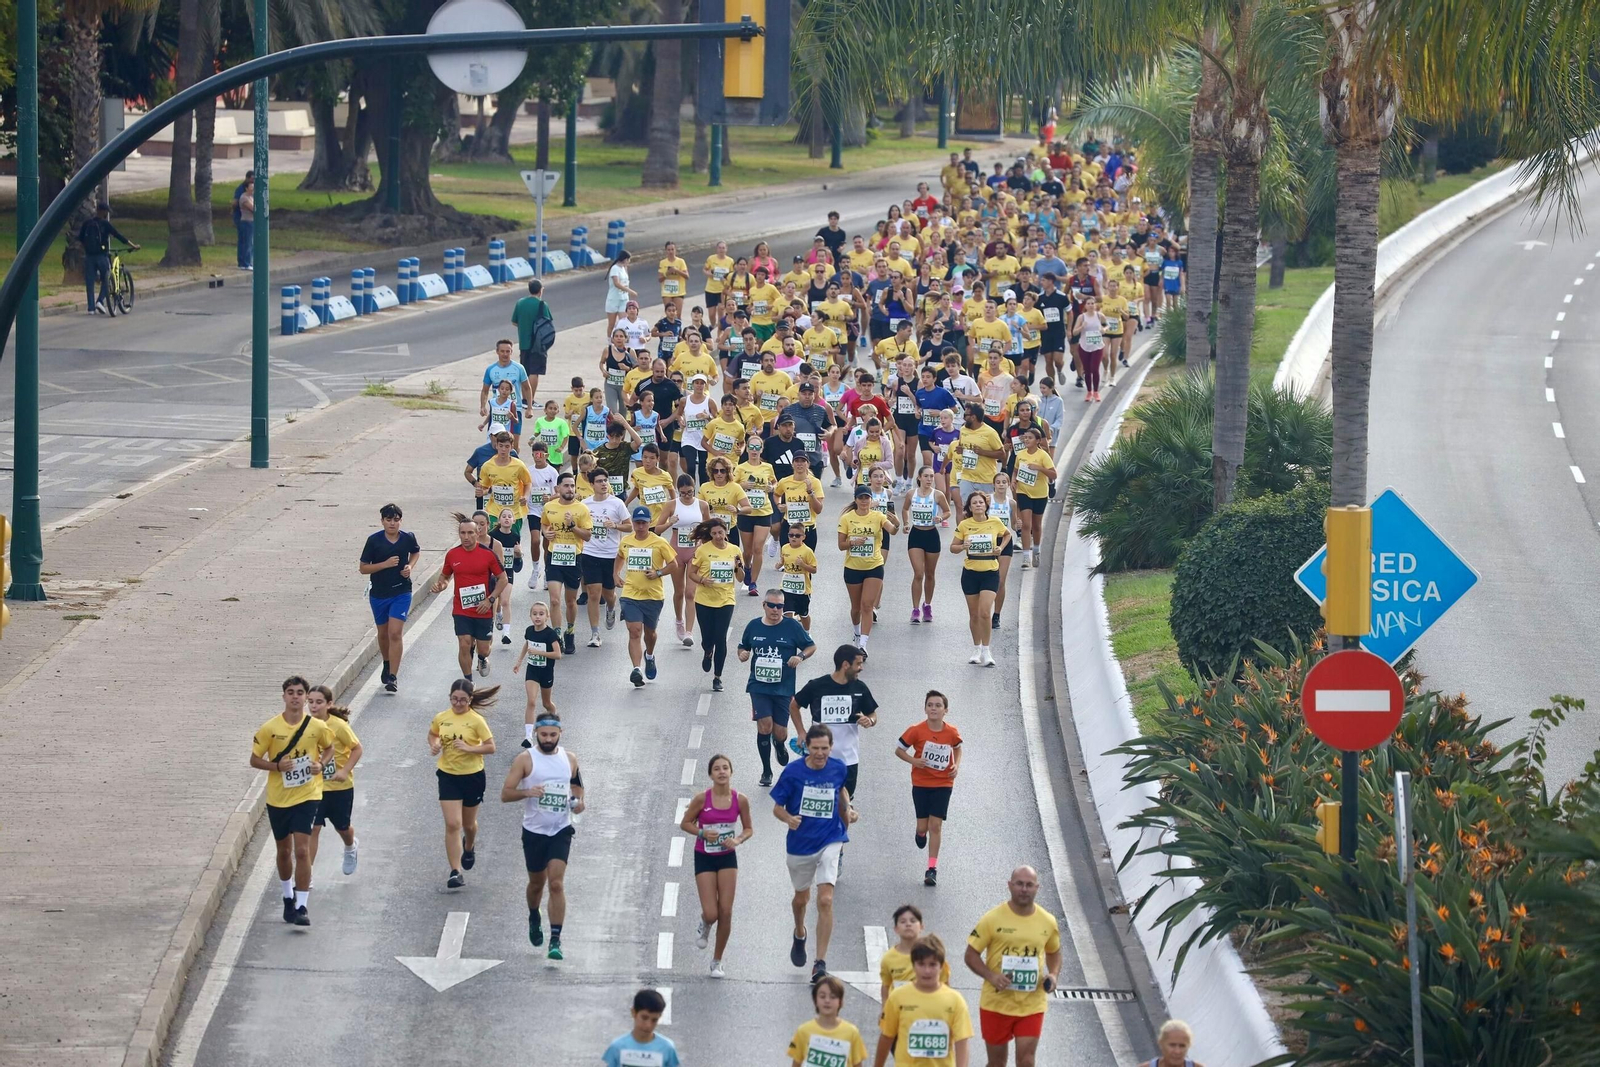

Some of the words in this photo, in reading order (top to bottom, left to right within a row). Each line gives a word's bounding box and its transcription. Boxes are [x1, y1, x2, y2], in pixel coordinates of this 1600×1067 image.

[750, 496, 764, 504] 1529
[788, 510, 810, 518] 23039
[553, 552, 575, 561] 20902
[629, 557, 650, 566] 21561
[710, 570, 732, 578] 21562
[783, 581, 804, 589] 22057
[1372, 579, 1442, 602] SICA
[462, 594, 486, 604] 23619
[756, 668, 780, 676] 24734
[822, 706, 850, 716] 10181
[923, 750, 950, 764] 10204
[285, 766, 311, 781] 8510
[802, 800, 832, 811] 23621
[1009, 971, 1036, 983] 1910
[910, 1036, 946, 1048] 21688
[808, 1050, 845, 1067] 21797
